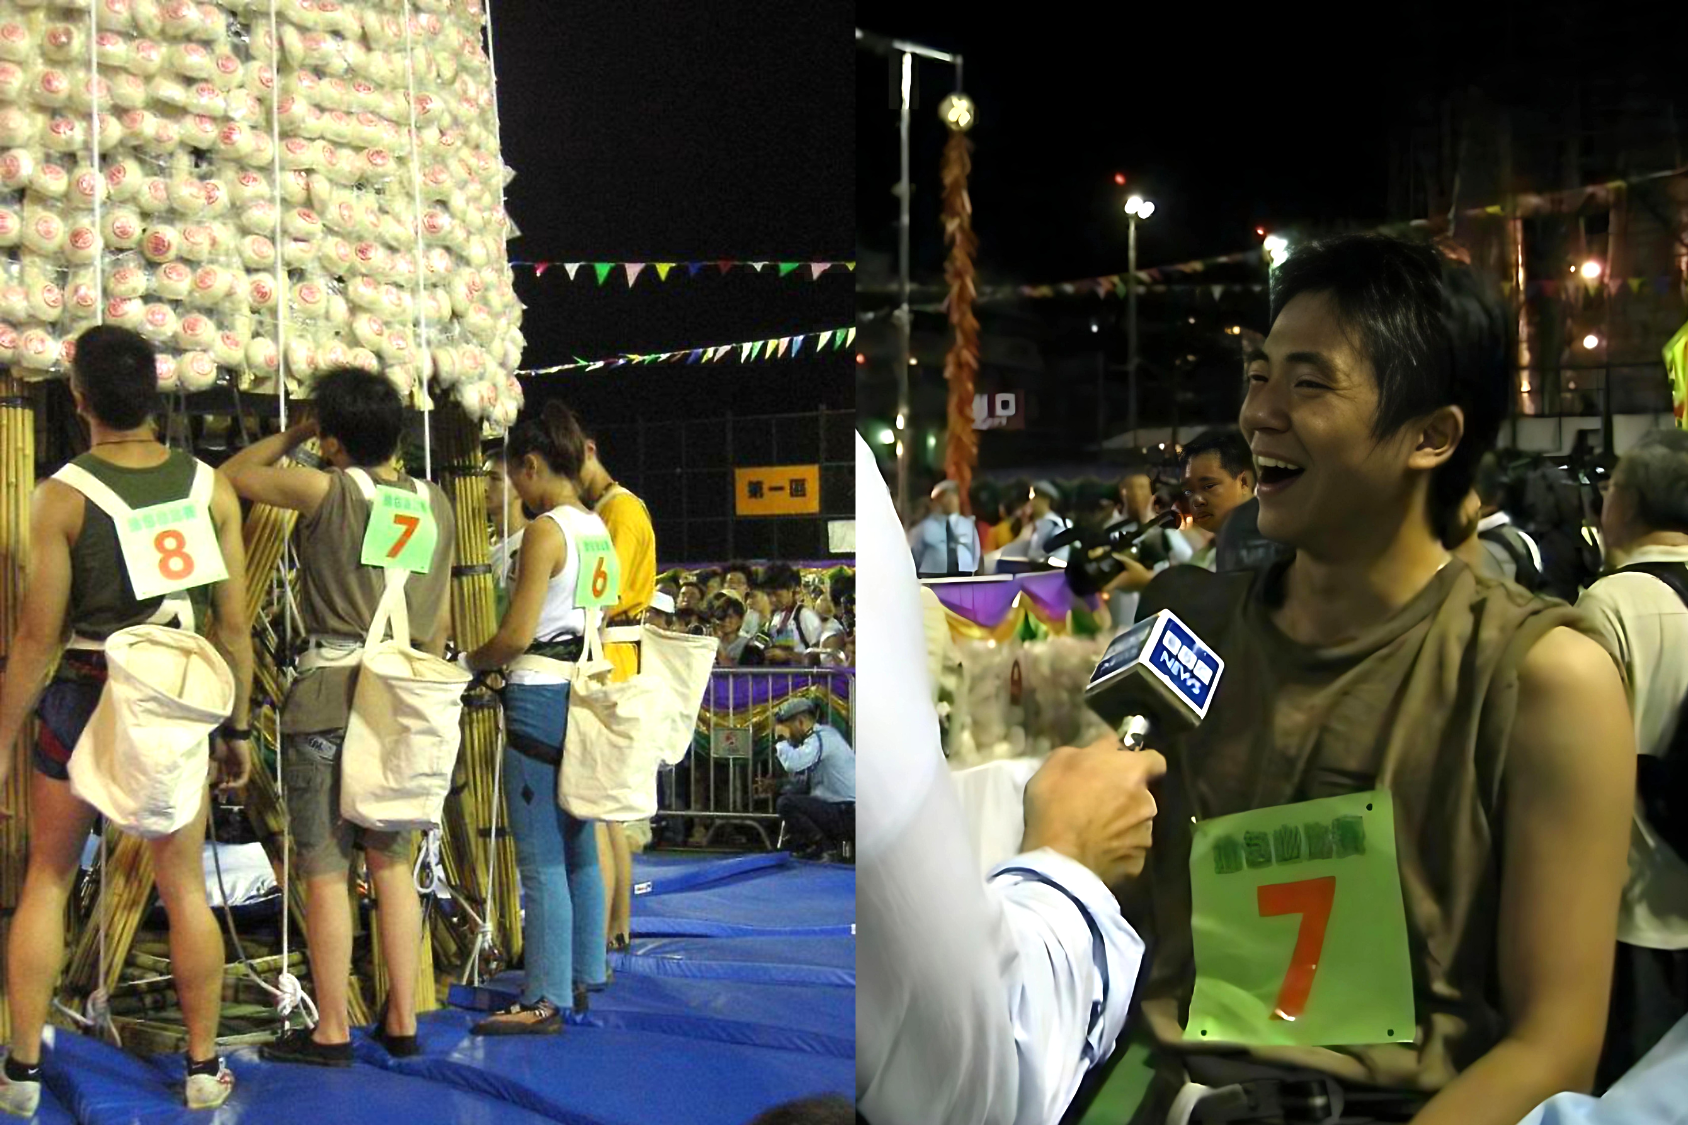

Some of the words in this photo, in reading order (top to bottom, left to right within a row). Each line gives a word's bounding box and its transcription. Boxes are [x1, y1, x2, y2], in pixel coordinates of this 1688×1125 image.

[154, 530, 194, 580] 8
[386, 514, 420, 558] 7
[592, 557, 607, 598] 6
[1257, 876, 1336, 1021] 7
